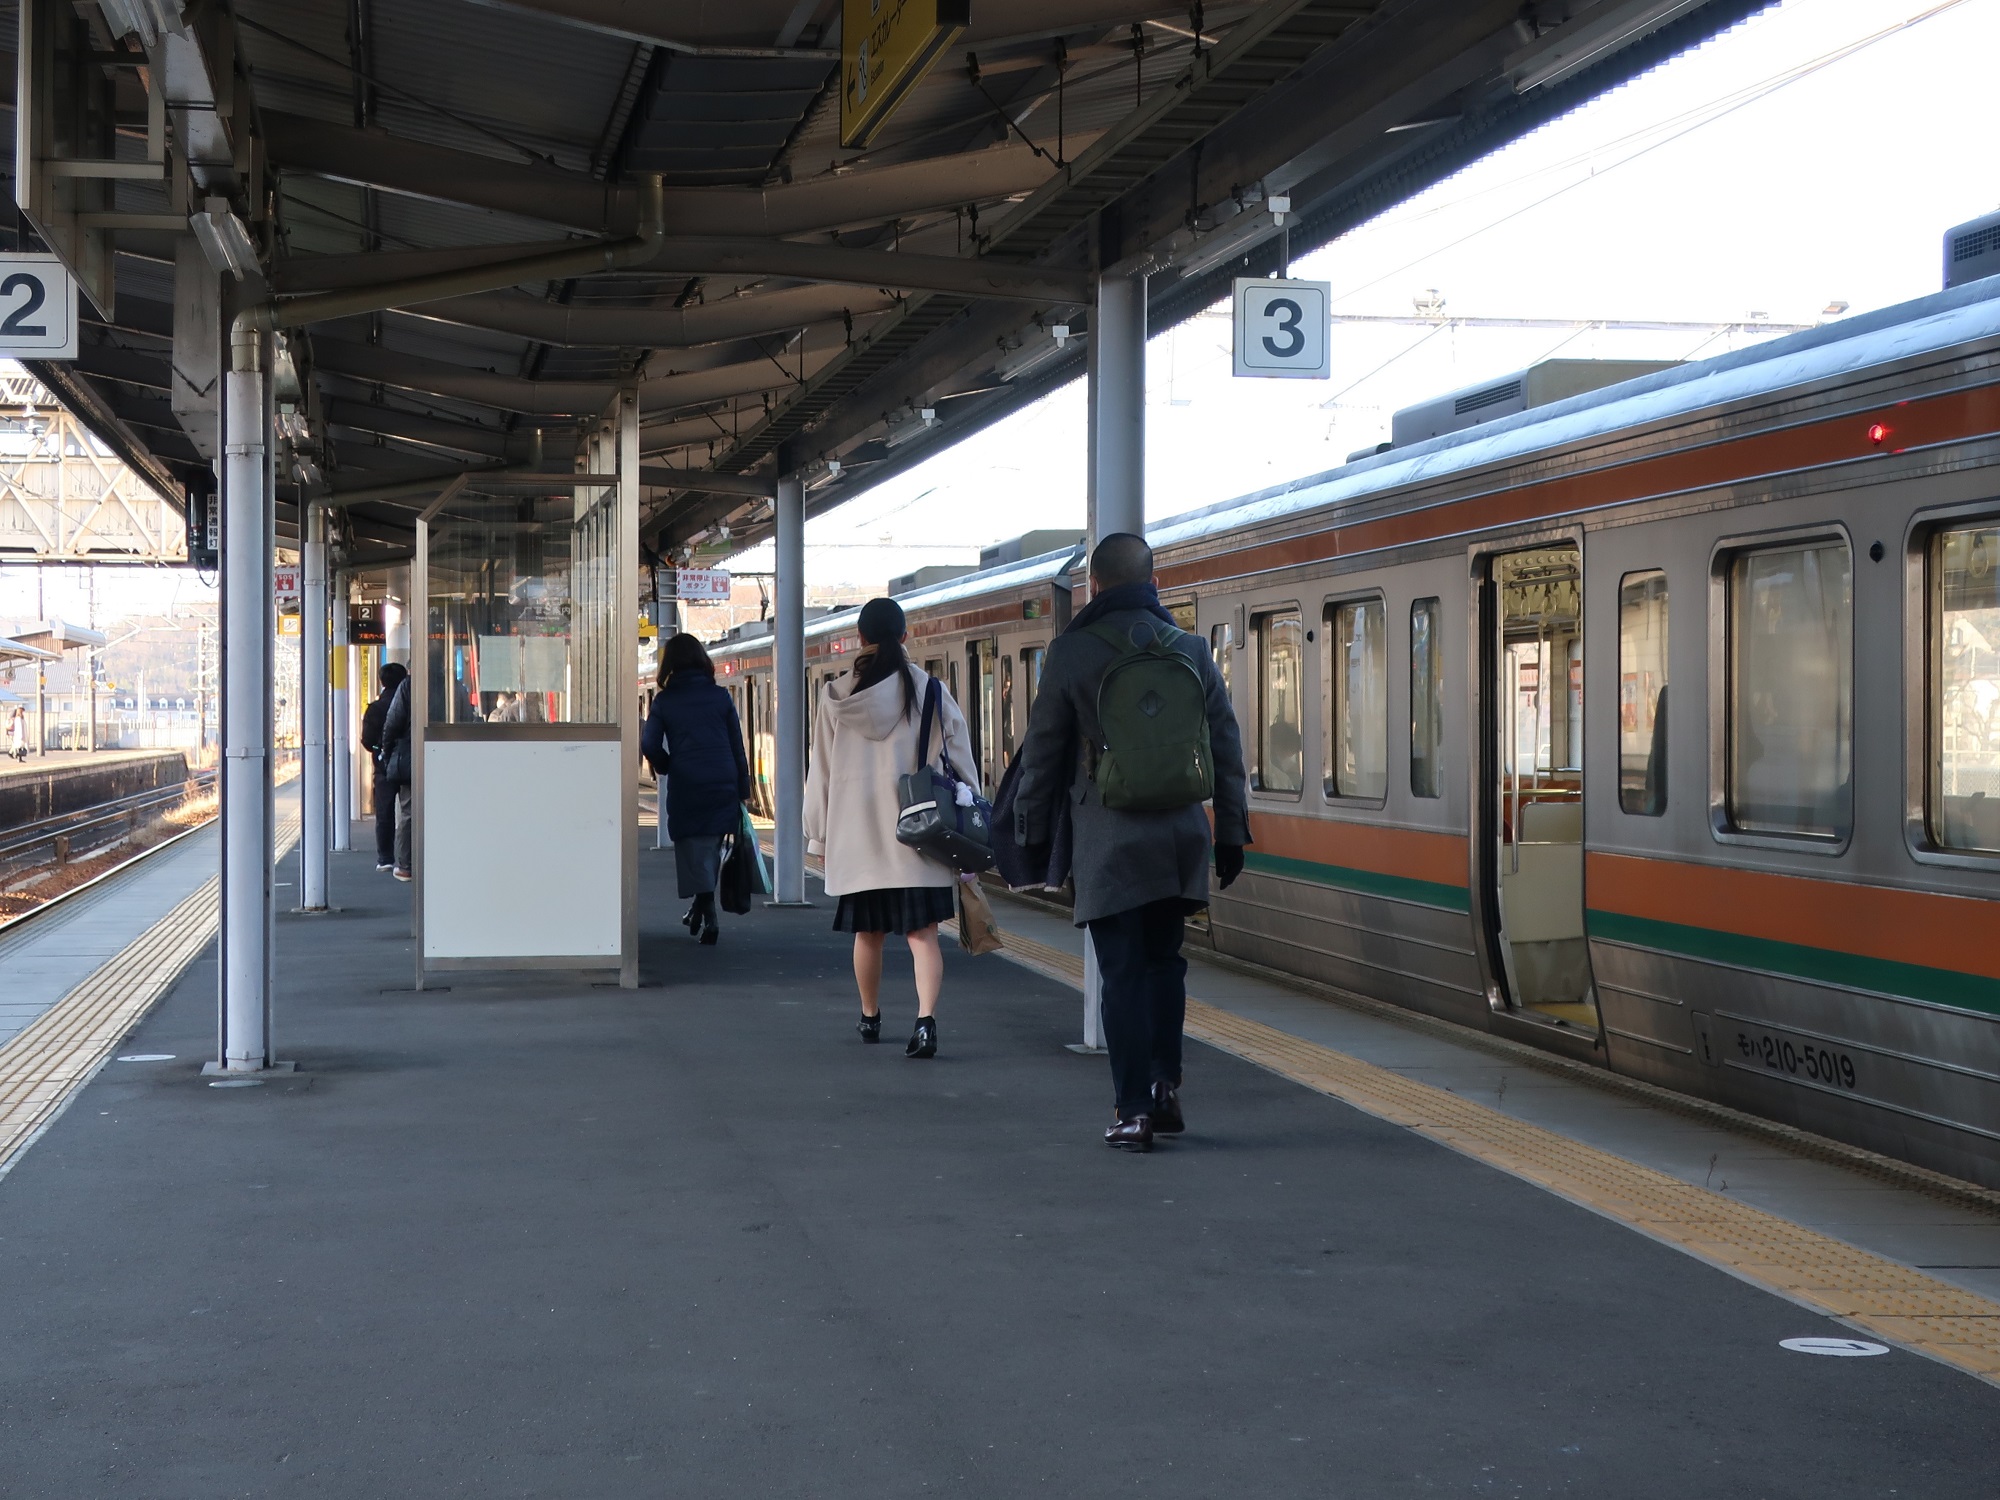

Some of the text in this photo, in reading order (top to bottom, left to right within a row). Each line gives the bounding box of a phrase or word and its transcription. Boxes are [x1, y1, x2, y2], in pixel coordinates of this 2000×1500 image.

[0, 272, 47, 337] 2
[1262, 298, 1305, 358] 3
[682, 574, 711, 582] 非常停止
[685, 582, 707, 590] ボタン
[361, 607, 370, 619] 2
[1737, 1033, 1856, 1089] モハ210-5019
